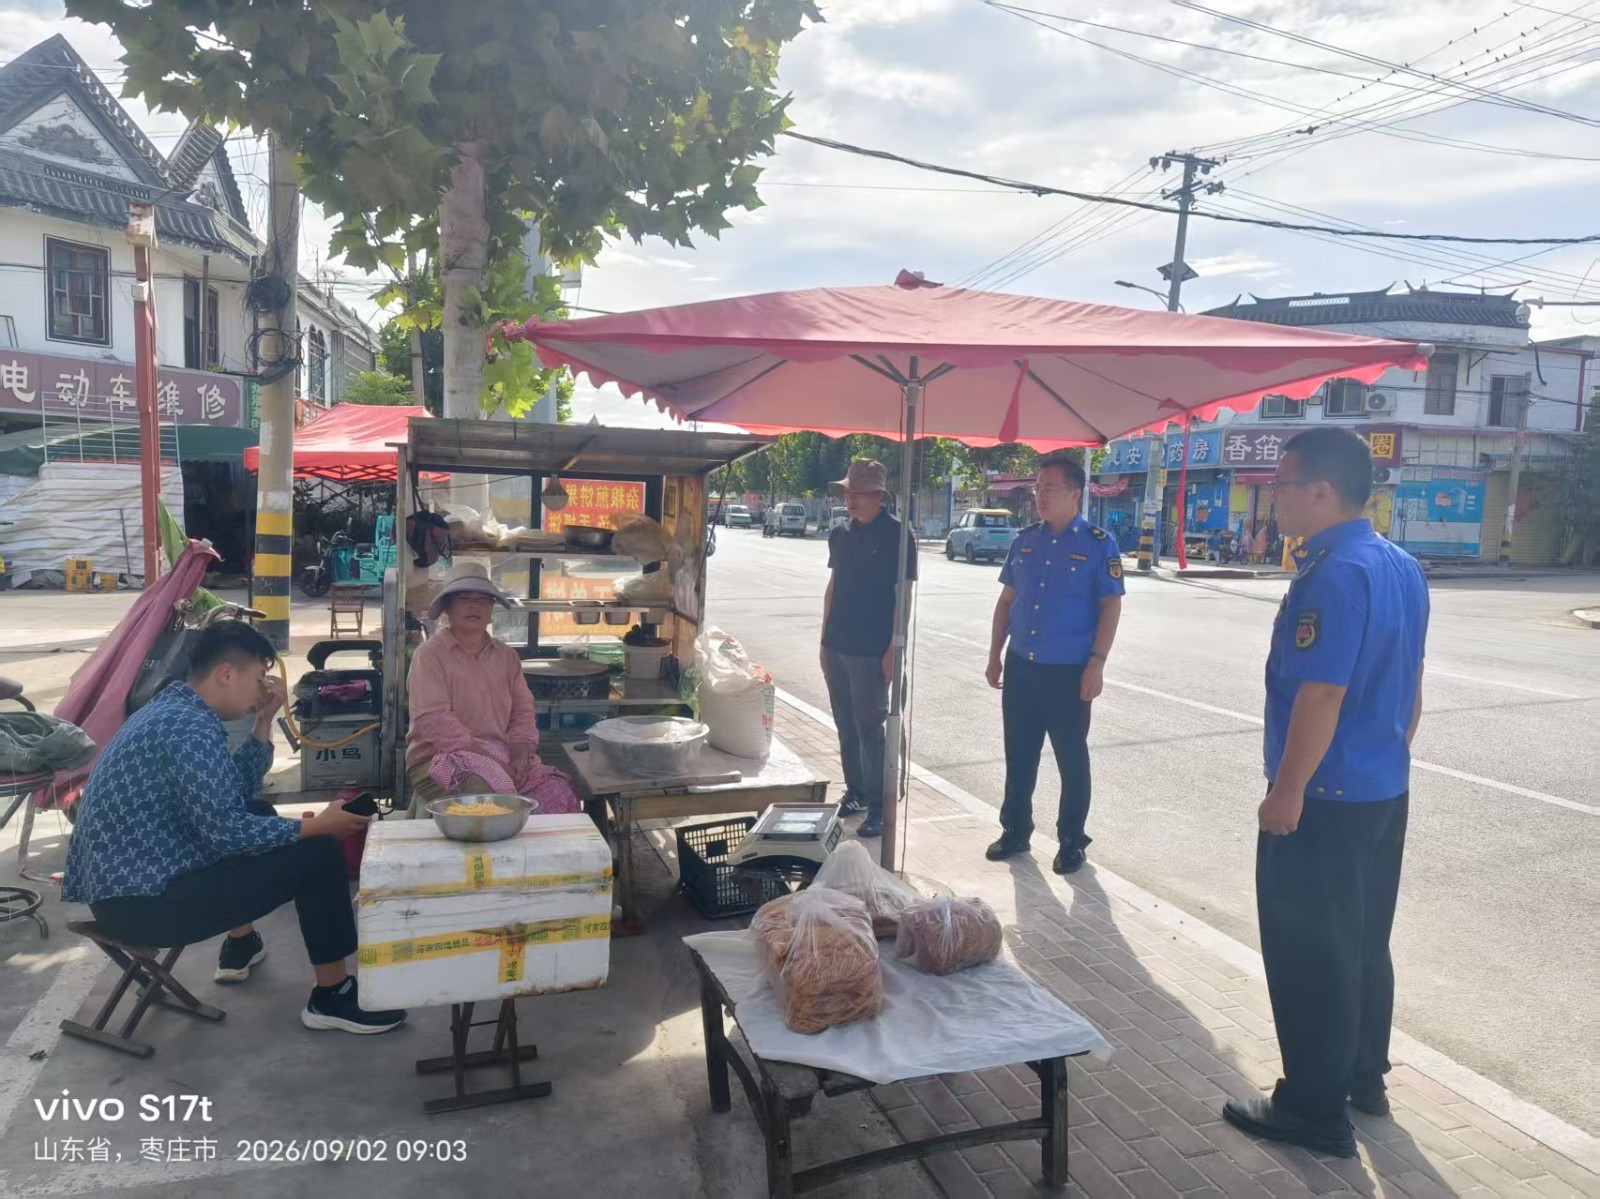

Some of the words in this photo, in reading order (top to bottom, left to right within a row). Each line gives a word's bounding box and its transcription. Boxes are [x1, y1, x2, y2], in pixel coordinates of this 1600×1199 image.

[2, 359, 226, 420] 电动车维修
[1225, 434, 1286, 461] 香箔
[1370, 432, 1395, 459] 圈
